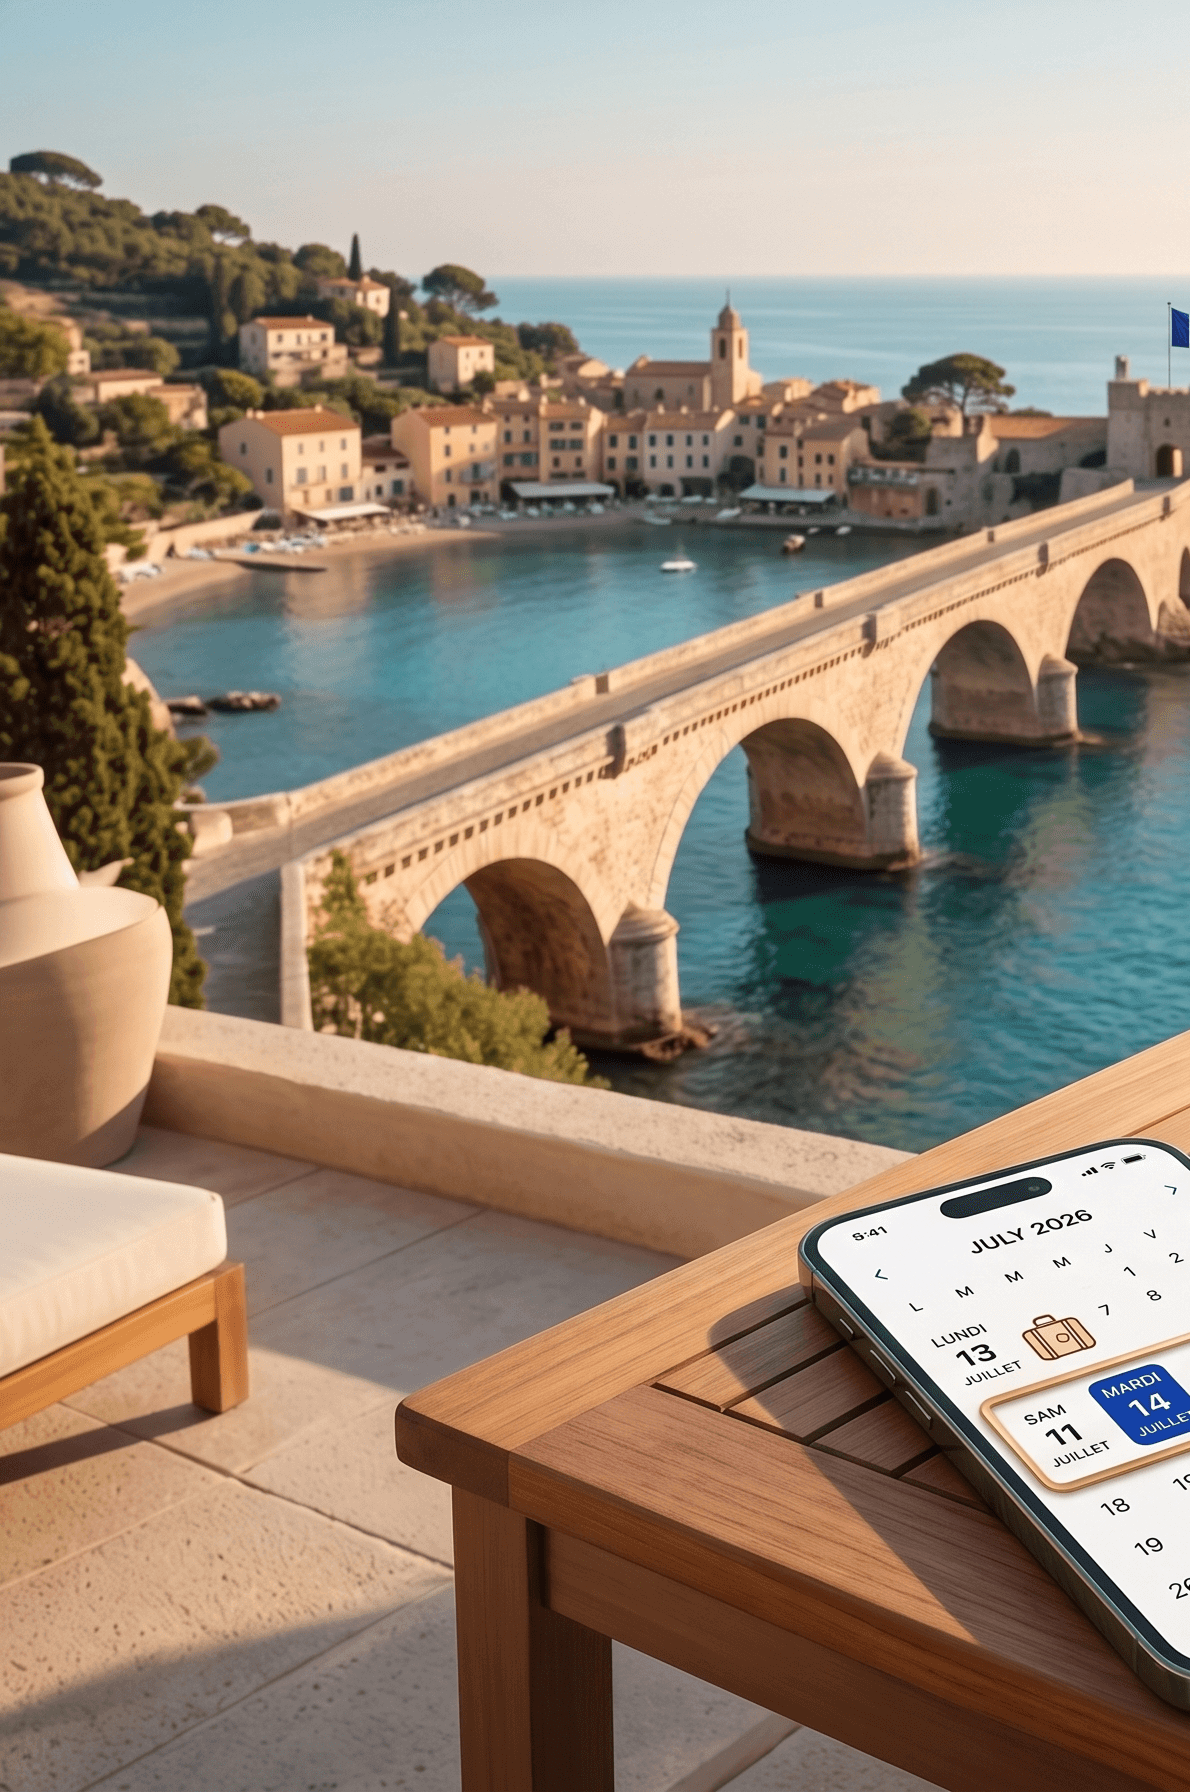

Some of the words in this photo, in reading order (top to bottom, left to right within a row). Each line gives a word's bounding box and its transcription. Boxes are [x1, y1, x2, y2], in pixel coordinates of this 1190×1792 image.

[971, 1227, 1025, 1254] JULY
[1030, 1209, 1093, 1236] 2026
[908, 1302, 924, 1312] L
[954, 1285, 975, 1299] M
[1004, 1270, 1024, 1283] M
[1052, 1256, 1072, 1269] M
[1103, 1243, 1113, 1254] J
[1143, 1228, 1157, 1239] V
[1123, 1266, 1136, 1277] 1
[1168, 1252, 1185, 1264] 2
[1097, 1303, 1110, 1316] 7
[1146, 1289, 1162, 1302] 8
[931, 1323, 987, 1348] LUNDI
[956, 1344, 997, 1366] 13
[965, 1360, 1021, 1386] JUILLET
[1101, 1371, 1162, 1399] MARDI
[1024, 1404, 1067, 1425] SAM
[1128, 1392, 1171, 1417] 14
[1045, 1423, 1083, 1446] 11
[1053, 1440, 1110, 1468] JUILLET
[1100, 1497, 1131, 1516] 18
[1134, 1537, 1164, 1556] 19
